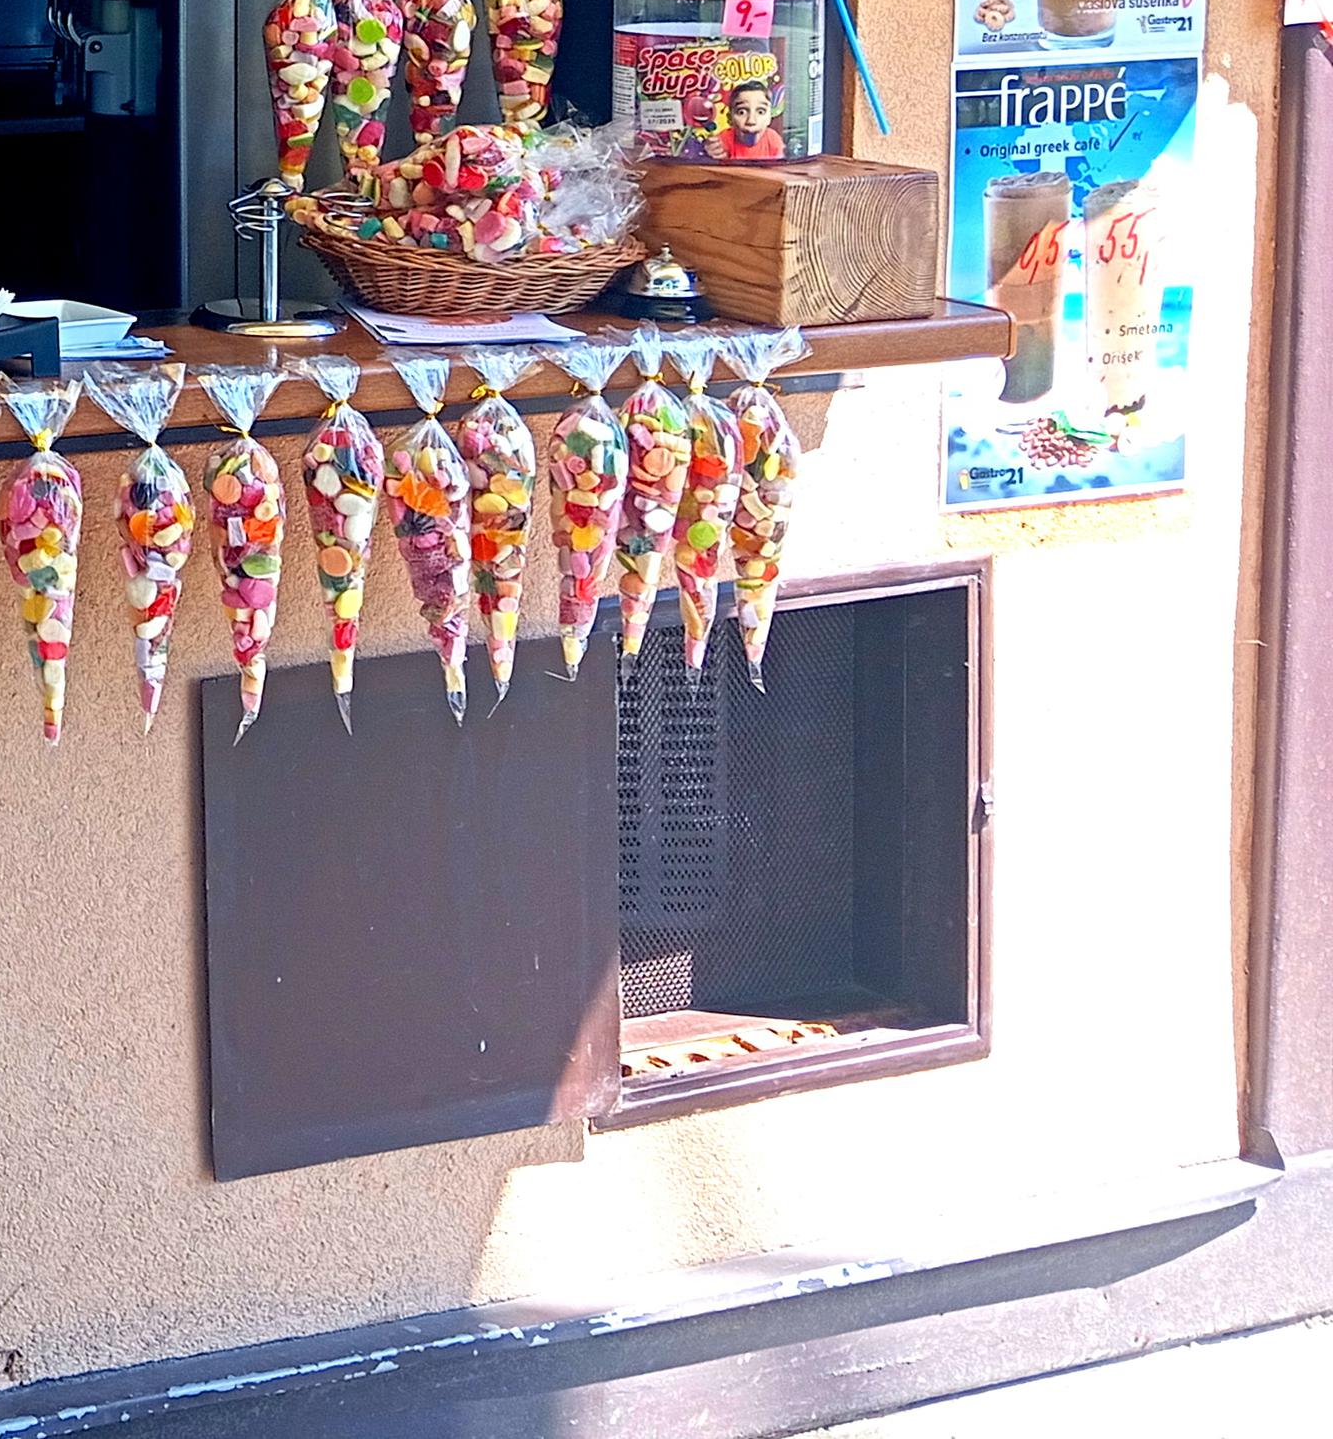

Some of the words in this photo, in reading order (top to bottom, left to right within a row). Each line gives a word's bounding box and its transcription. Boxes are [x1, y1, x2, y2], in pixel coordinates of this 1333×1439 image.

[735, 0, 767, 33] 9,-
[638, 47, 716, 75] Space
[713, 53, 777, 82] COLOR
[642, 66, 711, 97] chupi
[1000, 66, 1126, 128] frappé
[980, 139, 1032, 158] Original
[1034, 137, 1070, 156] greek
[1118, 322, 1173, 337] Smetana
